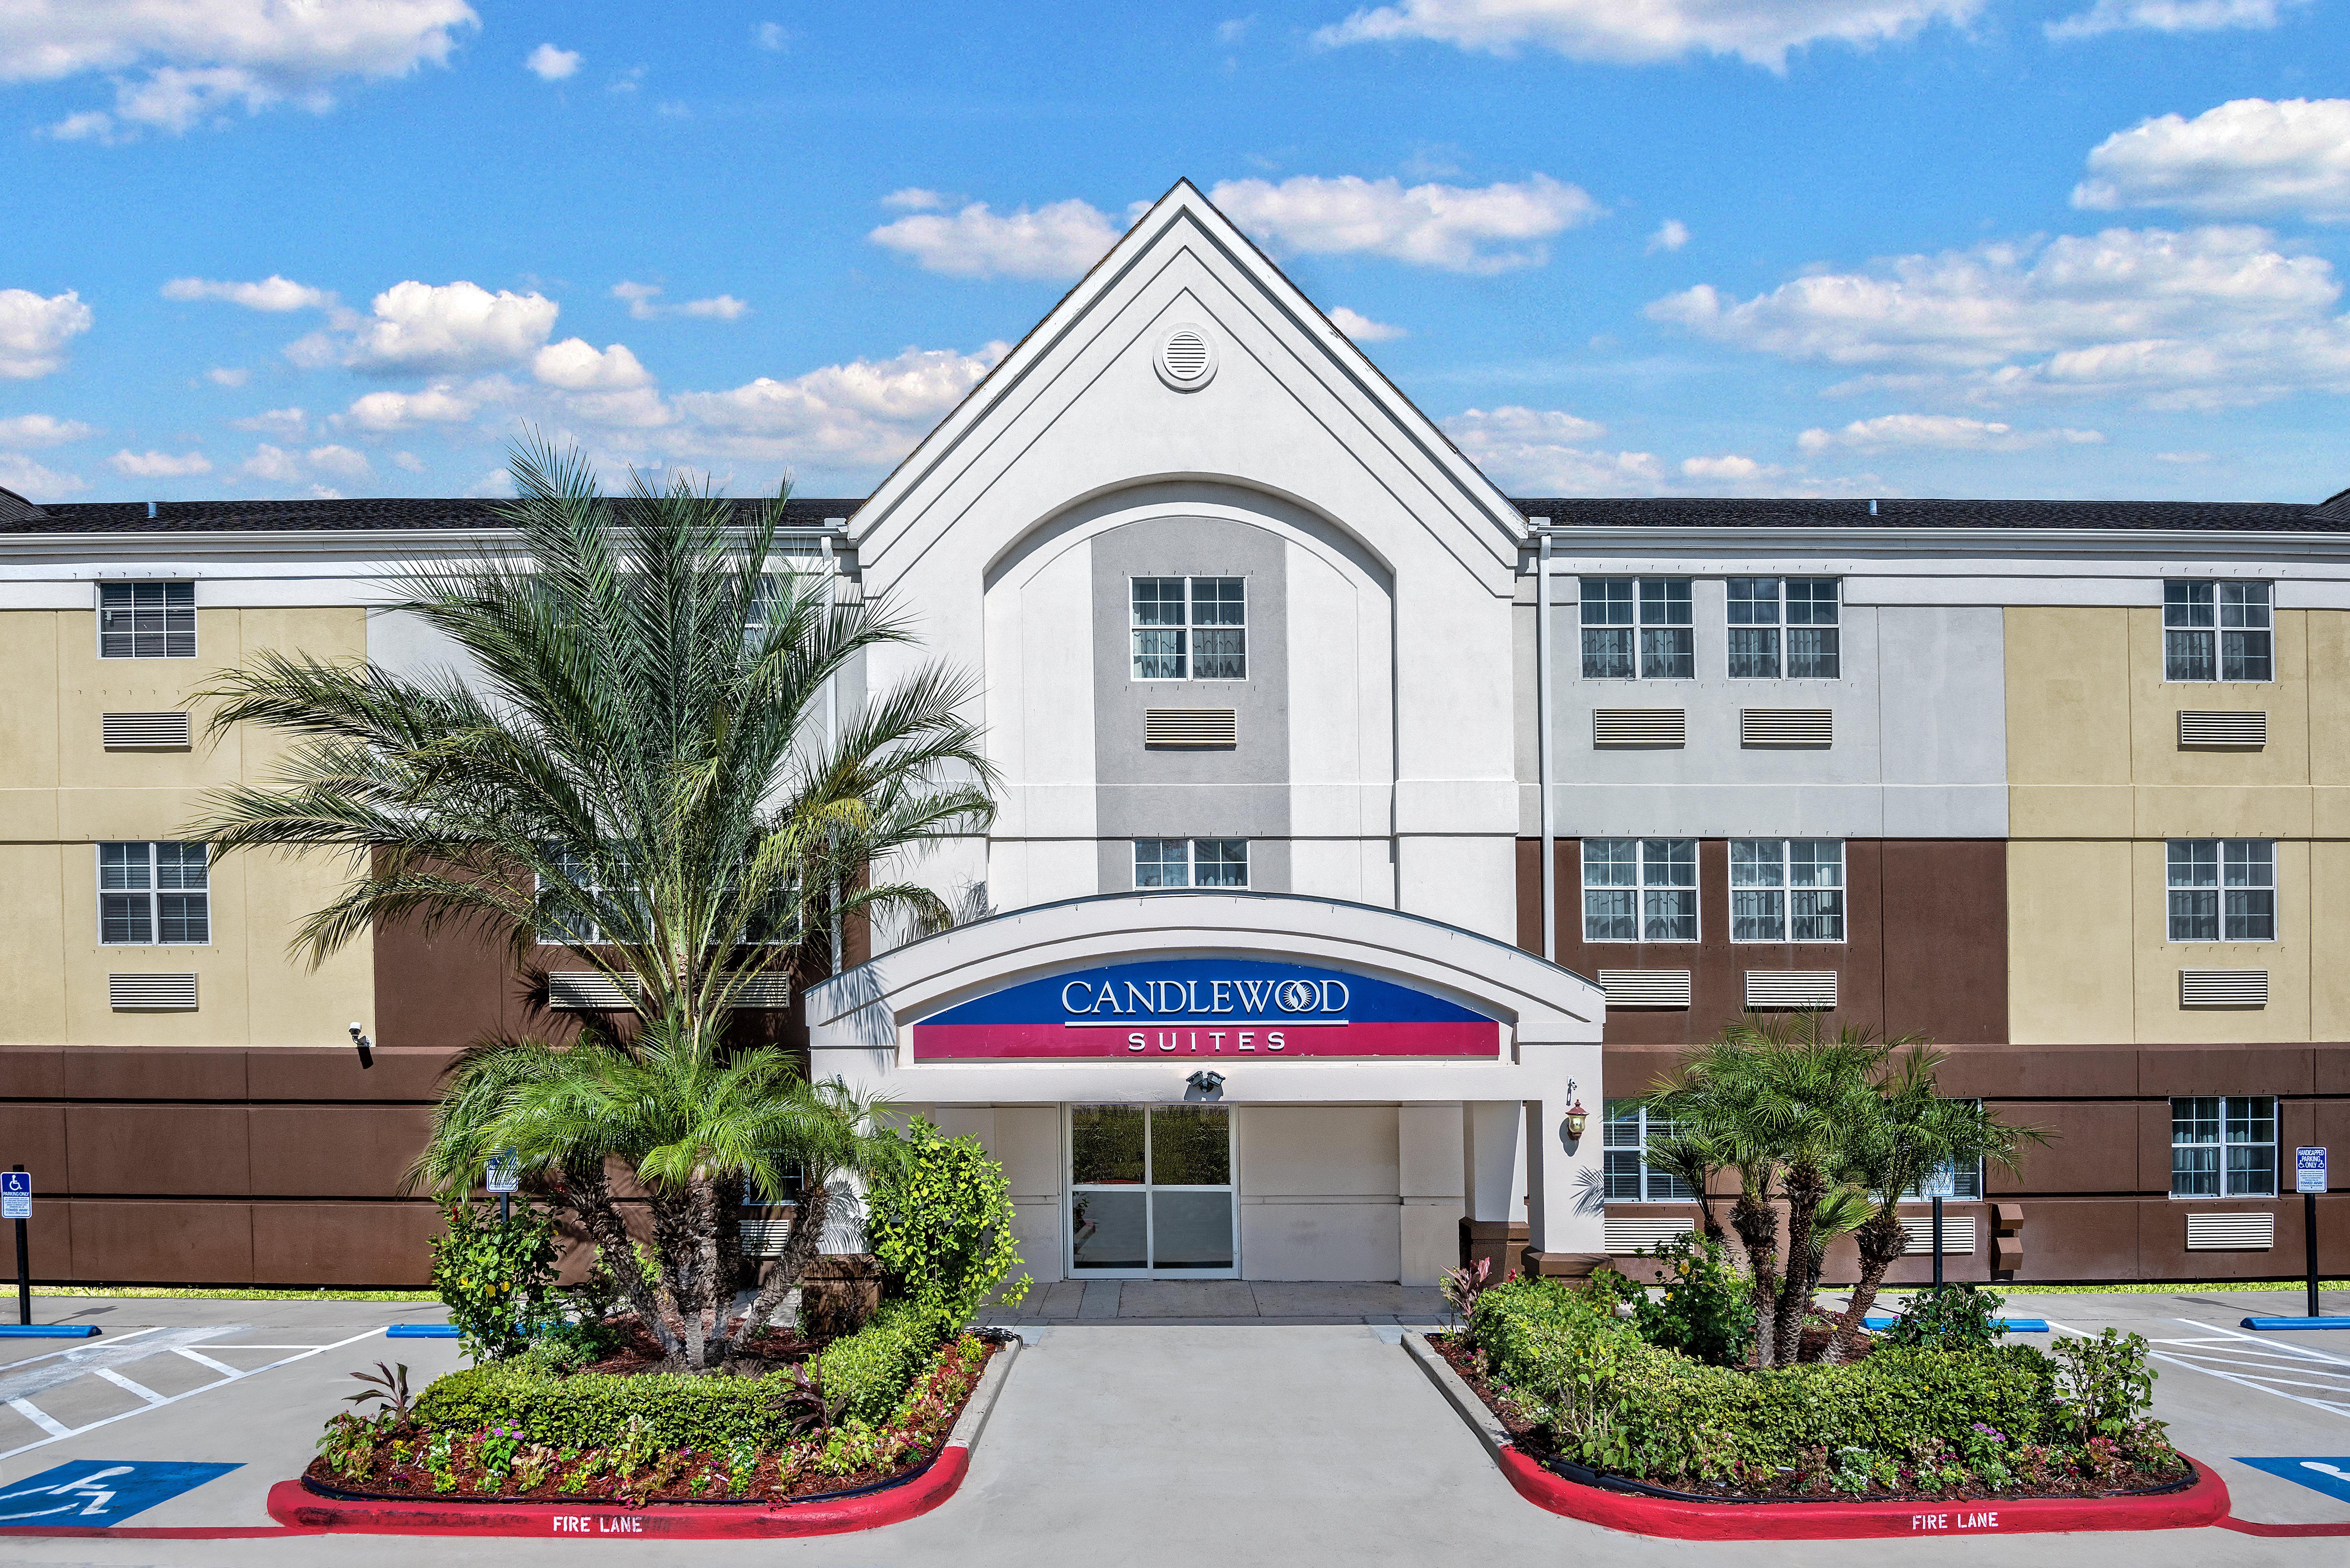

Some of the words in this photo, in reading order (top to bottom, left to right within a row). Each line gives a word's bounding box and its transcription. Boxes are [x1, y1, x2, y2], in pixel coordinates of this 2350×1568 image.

[1062, 980, 1349, 1014] CANDLEWOOD
[1128, 1032, 1285, 1051] SUITES
[553, 1516, 591, 1532] FIRE
[600, 1516, 643, 1532] LANE
[1912, 1514, 1948, 1530] FIRE
[1957, 1512, 1999, 1528] LANE
